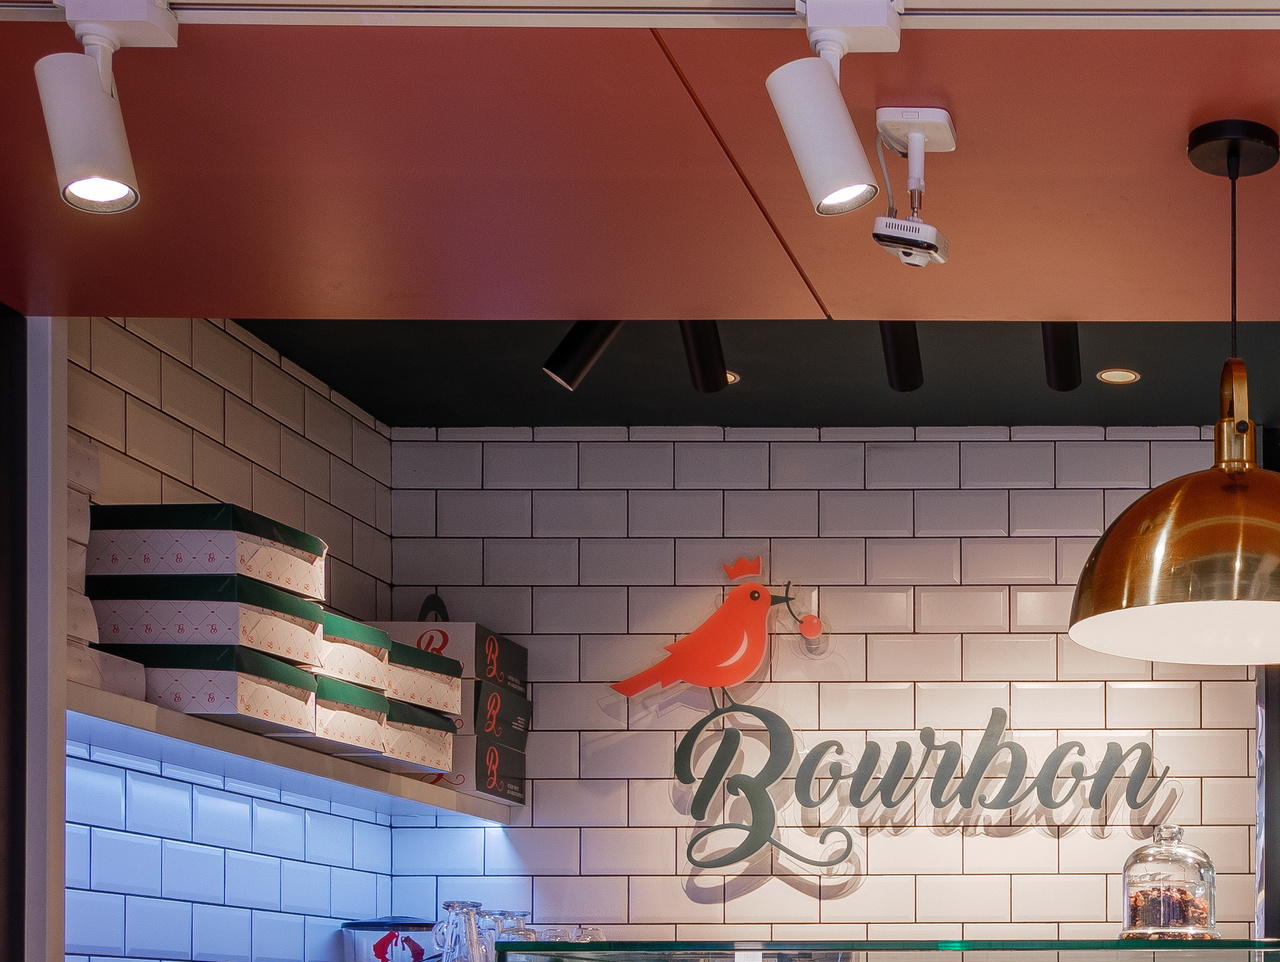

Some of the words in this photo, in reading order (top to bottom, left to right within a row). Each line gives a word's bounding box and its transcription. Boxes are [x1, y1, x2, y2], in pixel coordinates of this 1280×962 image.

[486, 635, 504, 682] B
[485, 692, 502, 737] B
[486, 746, 504, 792] B
[674, 704, 1170, 868] Bourbon
